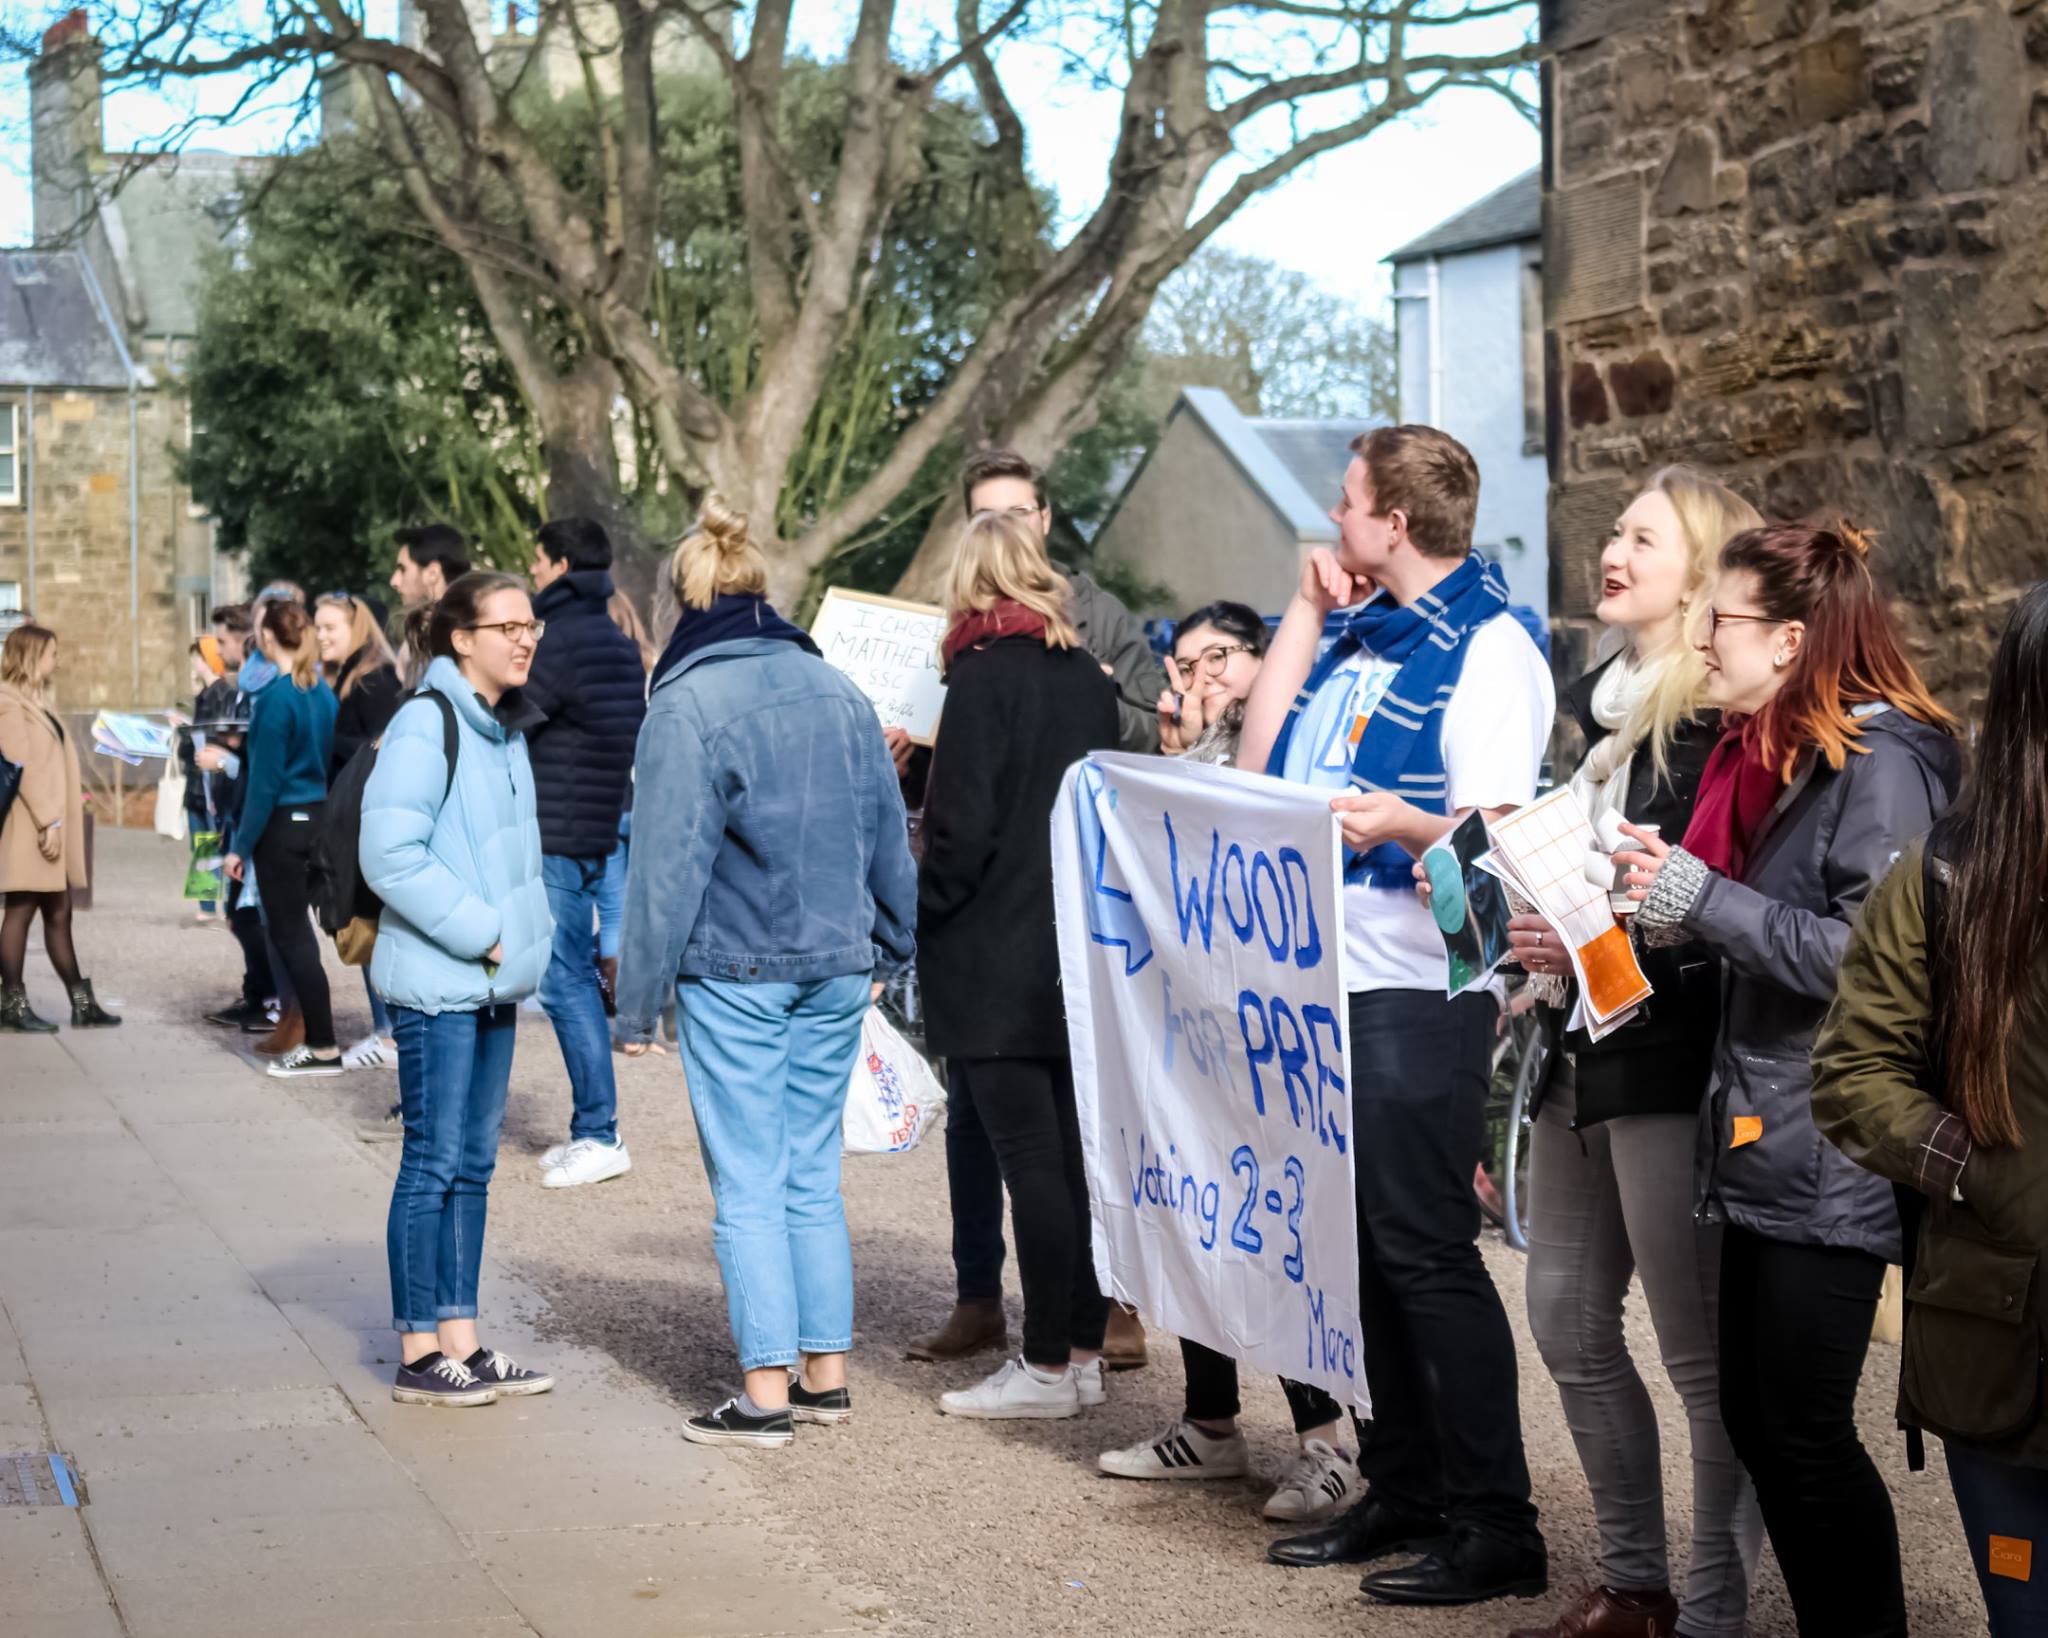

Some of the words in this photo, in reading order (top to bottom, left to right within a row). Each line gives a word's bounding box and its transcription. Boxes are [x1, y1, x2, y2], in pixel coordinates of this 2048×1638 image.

[854, 609, 874, 628] I
[868, 668, 904, 690] SSC
[1163, 810, 1322, 970] WOOD
[1120, 1127, 1220, 1252] Voting
